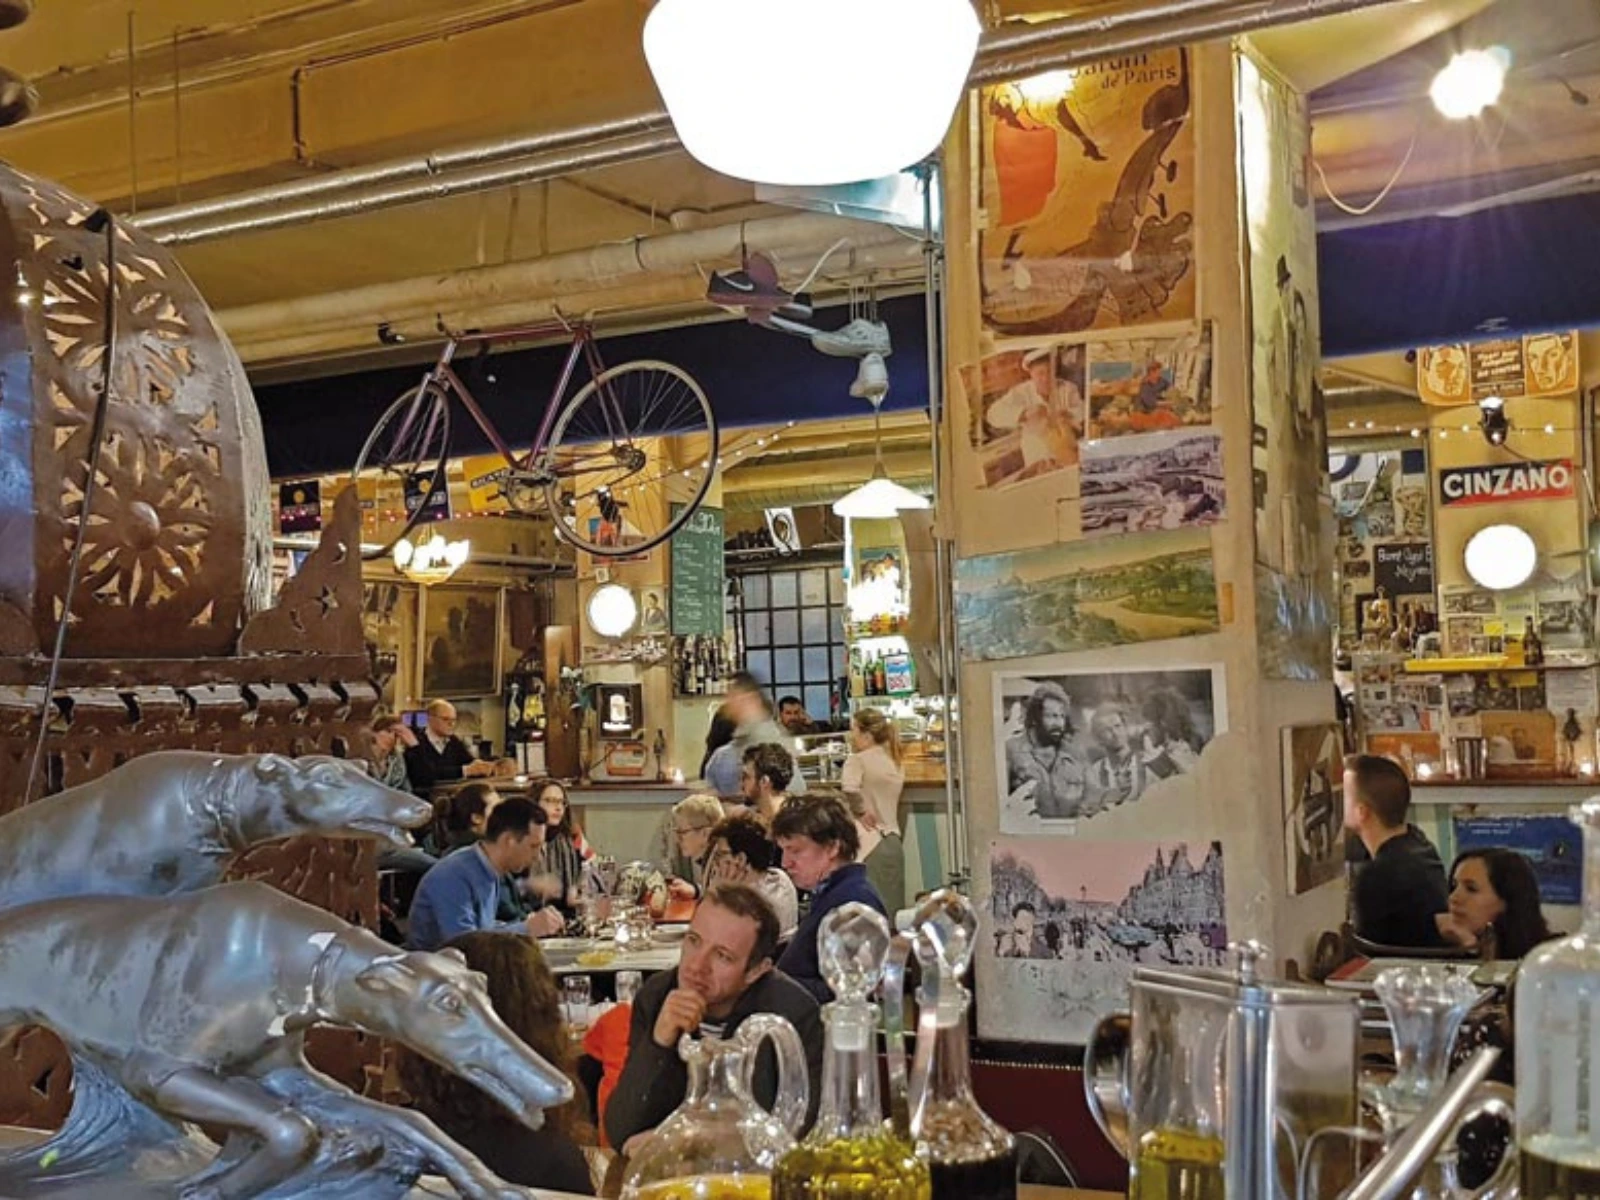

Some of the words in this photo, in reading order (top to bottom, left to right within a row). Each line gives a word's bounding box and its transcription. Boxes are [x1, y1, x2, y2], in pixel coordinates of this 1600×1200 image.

[1101, 73, 1118, 89] de
[1124, 64, 1177, 85] Paris
[1443, 465, 1570, 498] CINZANO
